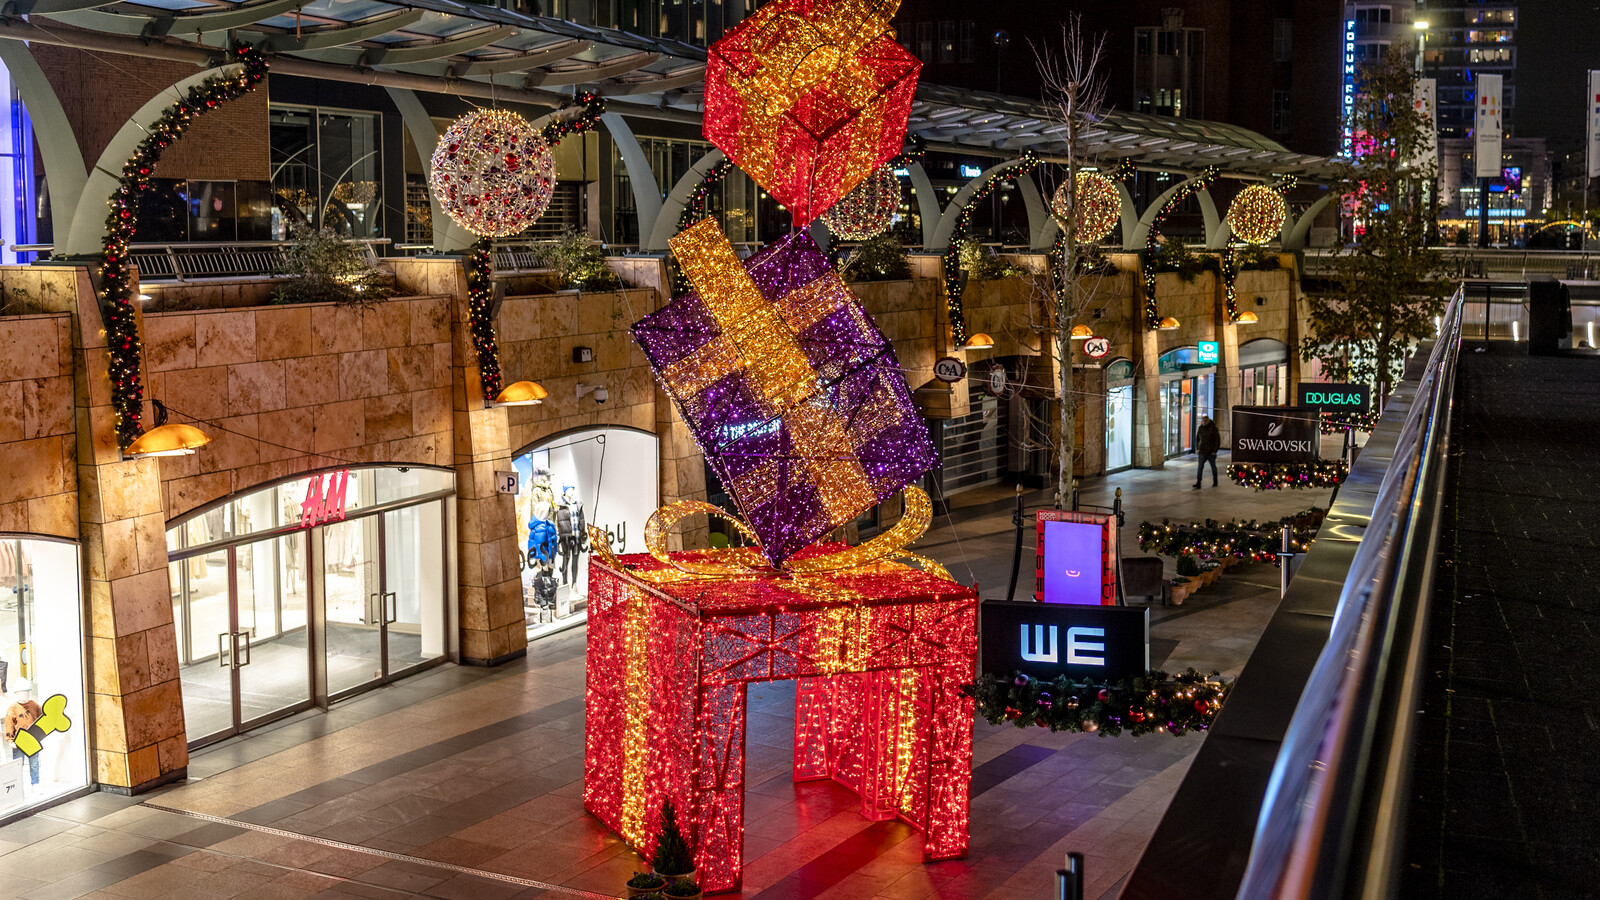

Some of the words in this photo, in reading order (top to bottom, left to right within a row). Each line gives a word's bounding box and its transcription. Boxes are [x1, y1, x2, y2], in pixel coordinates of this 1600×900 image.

[1346, 21, 1355, 74] FORUM
[938, 363, 959, 377] C&A
[1305, 392, 1361, 405] DOUGLAS
[1239, 438, 1311, 452] SWAROVSKI
[507, 477, 516, 492] P
[300, 469, 349, 527] H&M
[1020, 624, 1105, 666] WE
